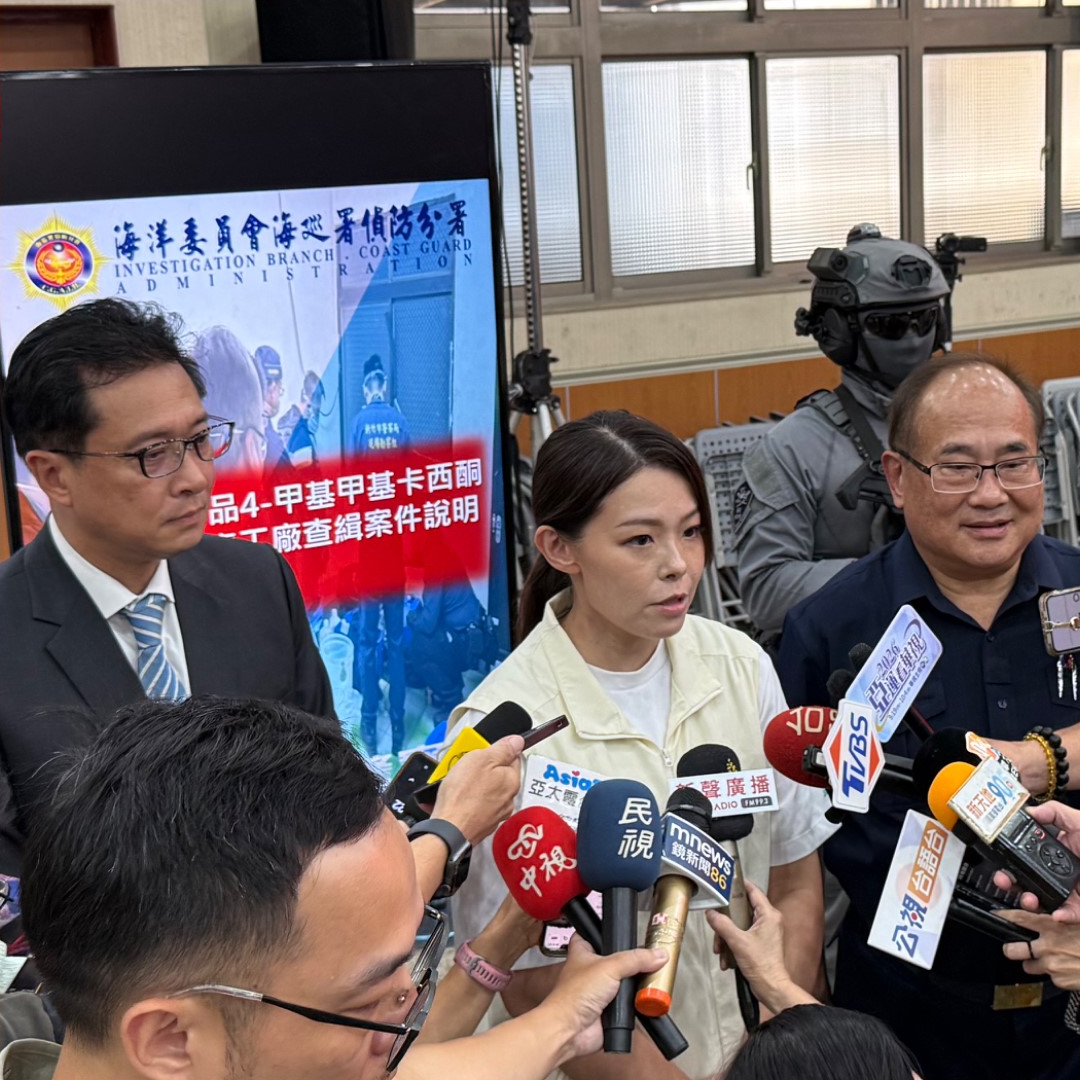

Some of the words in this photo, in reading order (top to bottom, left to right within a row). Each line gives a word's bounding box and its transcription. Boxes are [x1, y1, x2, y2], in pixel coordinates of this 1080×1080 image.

[113, 200, 467, 261] 海洋委員會海巡署偵防分署
[114, 254, 256, 278] INVESTIGATION
[267, 248, 334, 266] BRANCH
[359, 243, 411, 259] COAST
[420, 238, 472, 254] GUARD
[116, 253, 473, 295] ADMINISTRATION
[208, 457, 483, 526] 品4-甲基甲基卡西酮
[218, 494, 480, 553] 工廠查緝案件說明
[543, 764, 601, 791] Asia
[841, 712, 868, 798] TVBS
[528, 778, 583, 807] 亞太電
[676, 774, 770, 799] 聲廣播
[714, 801, 738, 811] ADIO
[618, 797, 655, 860] 民視
[670, 822, 732, 876] mnews
[520, 845, 578, 898] 中視
[910, 827, 945, 897] 台語台
[891, 893, 928, 958] 公視
